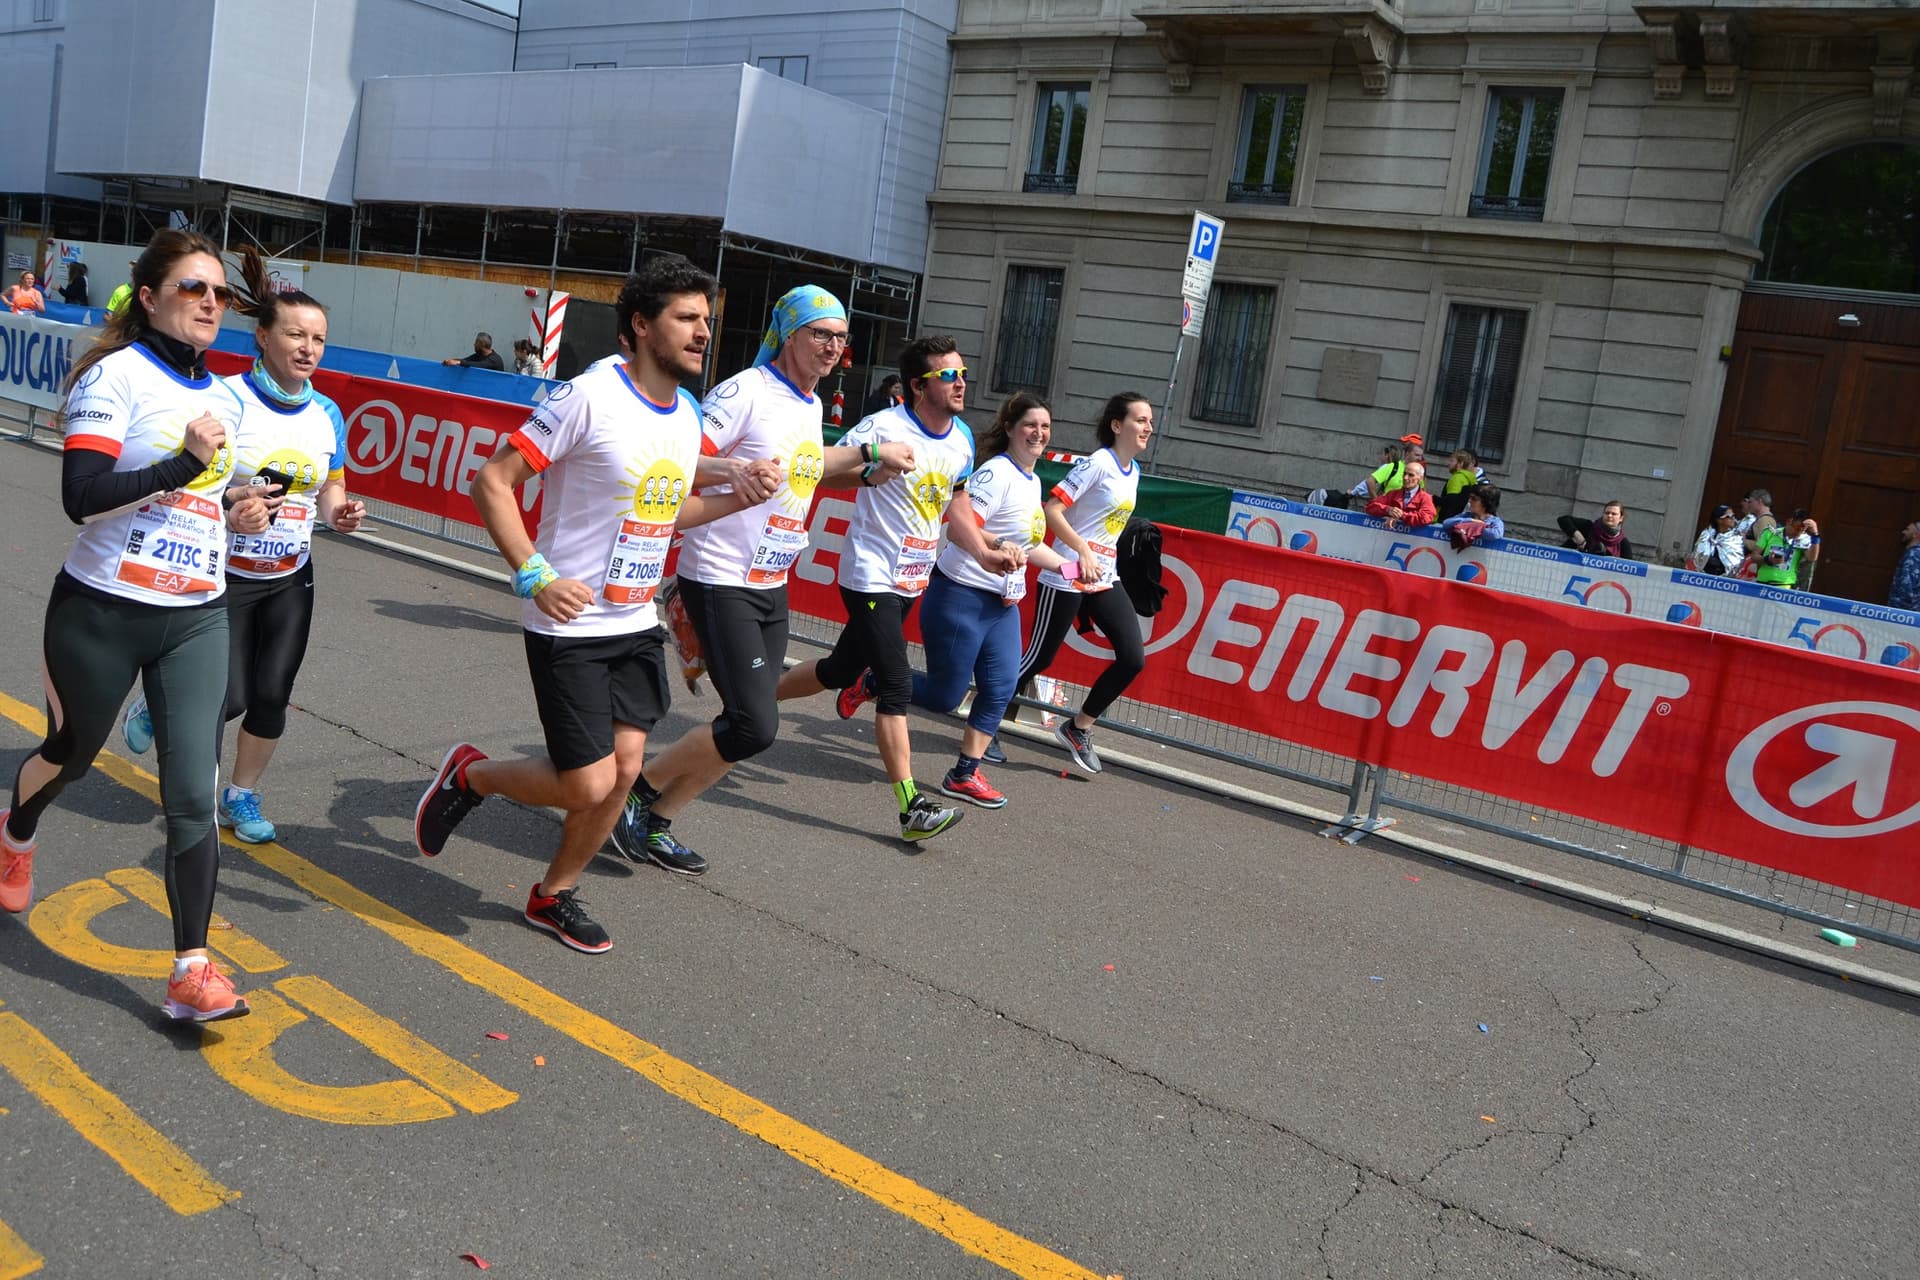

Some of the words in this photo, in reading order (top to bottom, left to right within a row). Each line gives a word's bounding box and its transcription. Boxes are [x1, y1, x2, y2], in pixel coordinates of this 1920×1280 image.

[1197, 225, 1213, 254] P
[1243, 495, 1288, 511] #corricon
[171, 513, 197, 525] RELAY
[1302, 506, 1348, 522] #corricon
[633, 525, 652, 534] EA7
[152, 538, 202, 568] 2113C
[251, 540, 294, 556] 2110C
[1505, 543, 1559, 560] #corricon
[254, 561, 280, 570] EA7
[1581, 555, 1638, 574] #corricon
[154, 571, 192, 591] EA7
[1680, 573, 1740, 593] #corricon
[628, 588, 650, 600] EA7
[1759, 587, 1821, 608] #corricon
[1850, 602, 1915, 625] #corricon
[1186, 578, 1690, 778] ENERVIT
